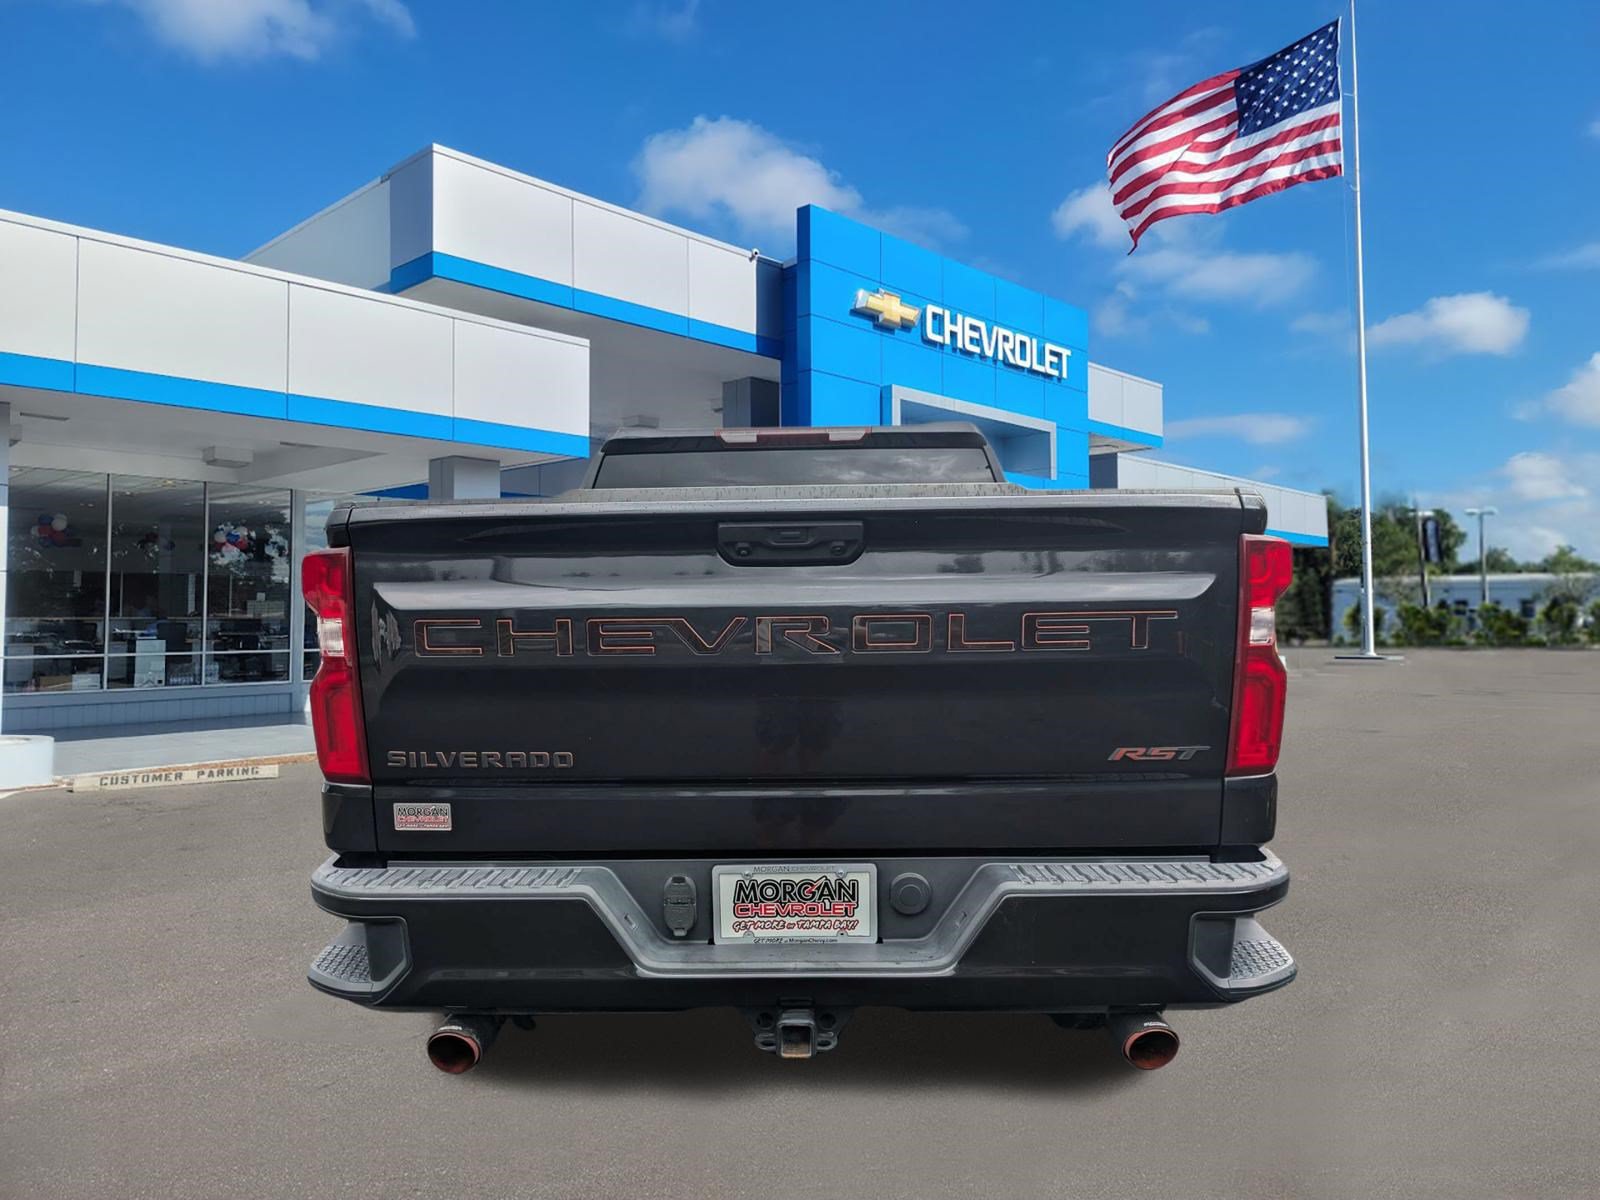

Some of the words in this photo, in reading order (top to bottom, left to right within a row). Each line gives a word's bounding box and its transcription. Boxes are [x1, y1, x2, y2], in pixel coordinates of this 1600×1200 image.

[925, 303, 1072, 380] CHEVROLET
[413, 610, 1178, 657] CHEVROLET
[386, 750, 575, 768] SILVERADO
[1107, 745, 1211, 761] RST
[99, 771, 183, 786] CUSTOMER
[196, 766, 260, 780] PARKING
[397, 806, 448, 816] MORGAN
[735, 877, 859, 904] MORGAN
[735, 903, 857, 917] CHEVROLET
[733, 920, 754, 932] GET
[753, 919, 786, 931] MORE
[795, 919, 831, 931] TAMPA
